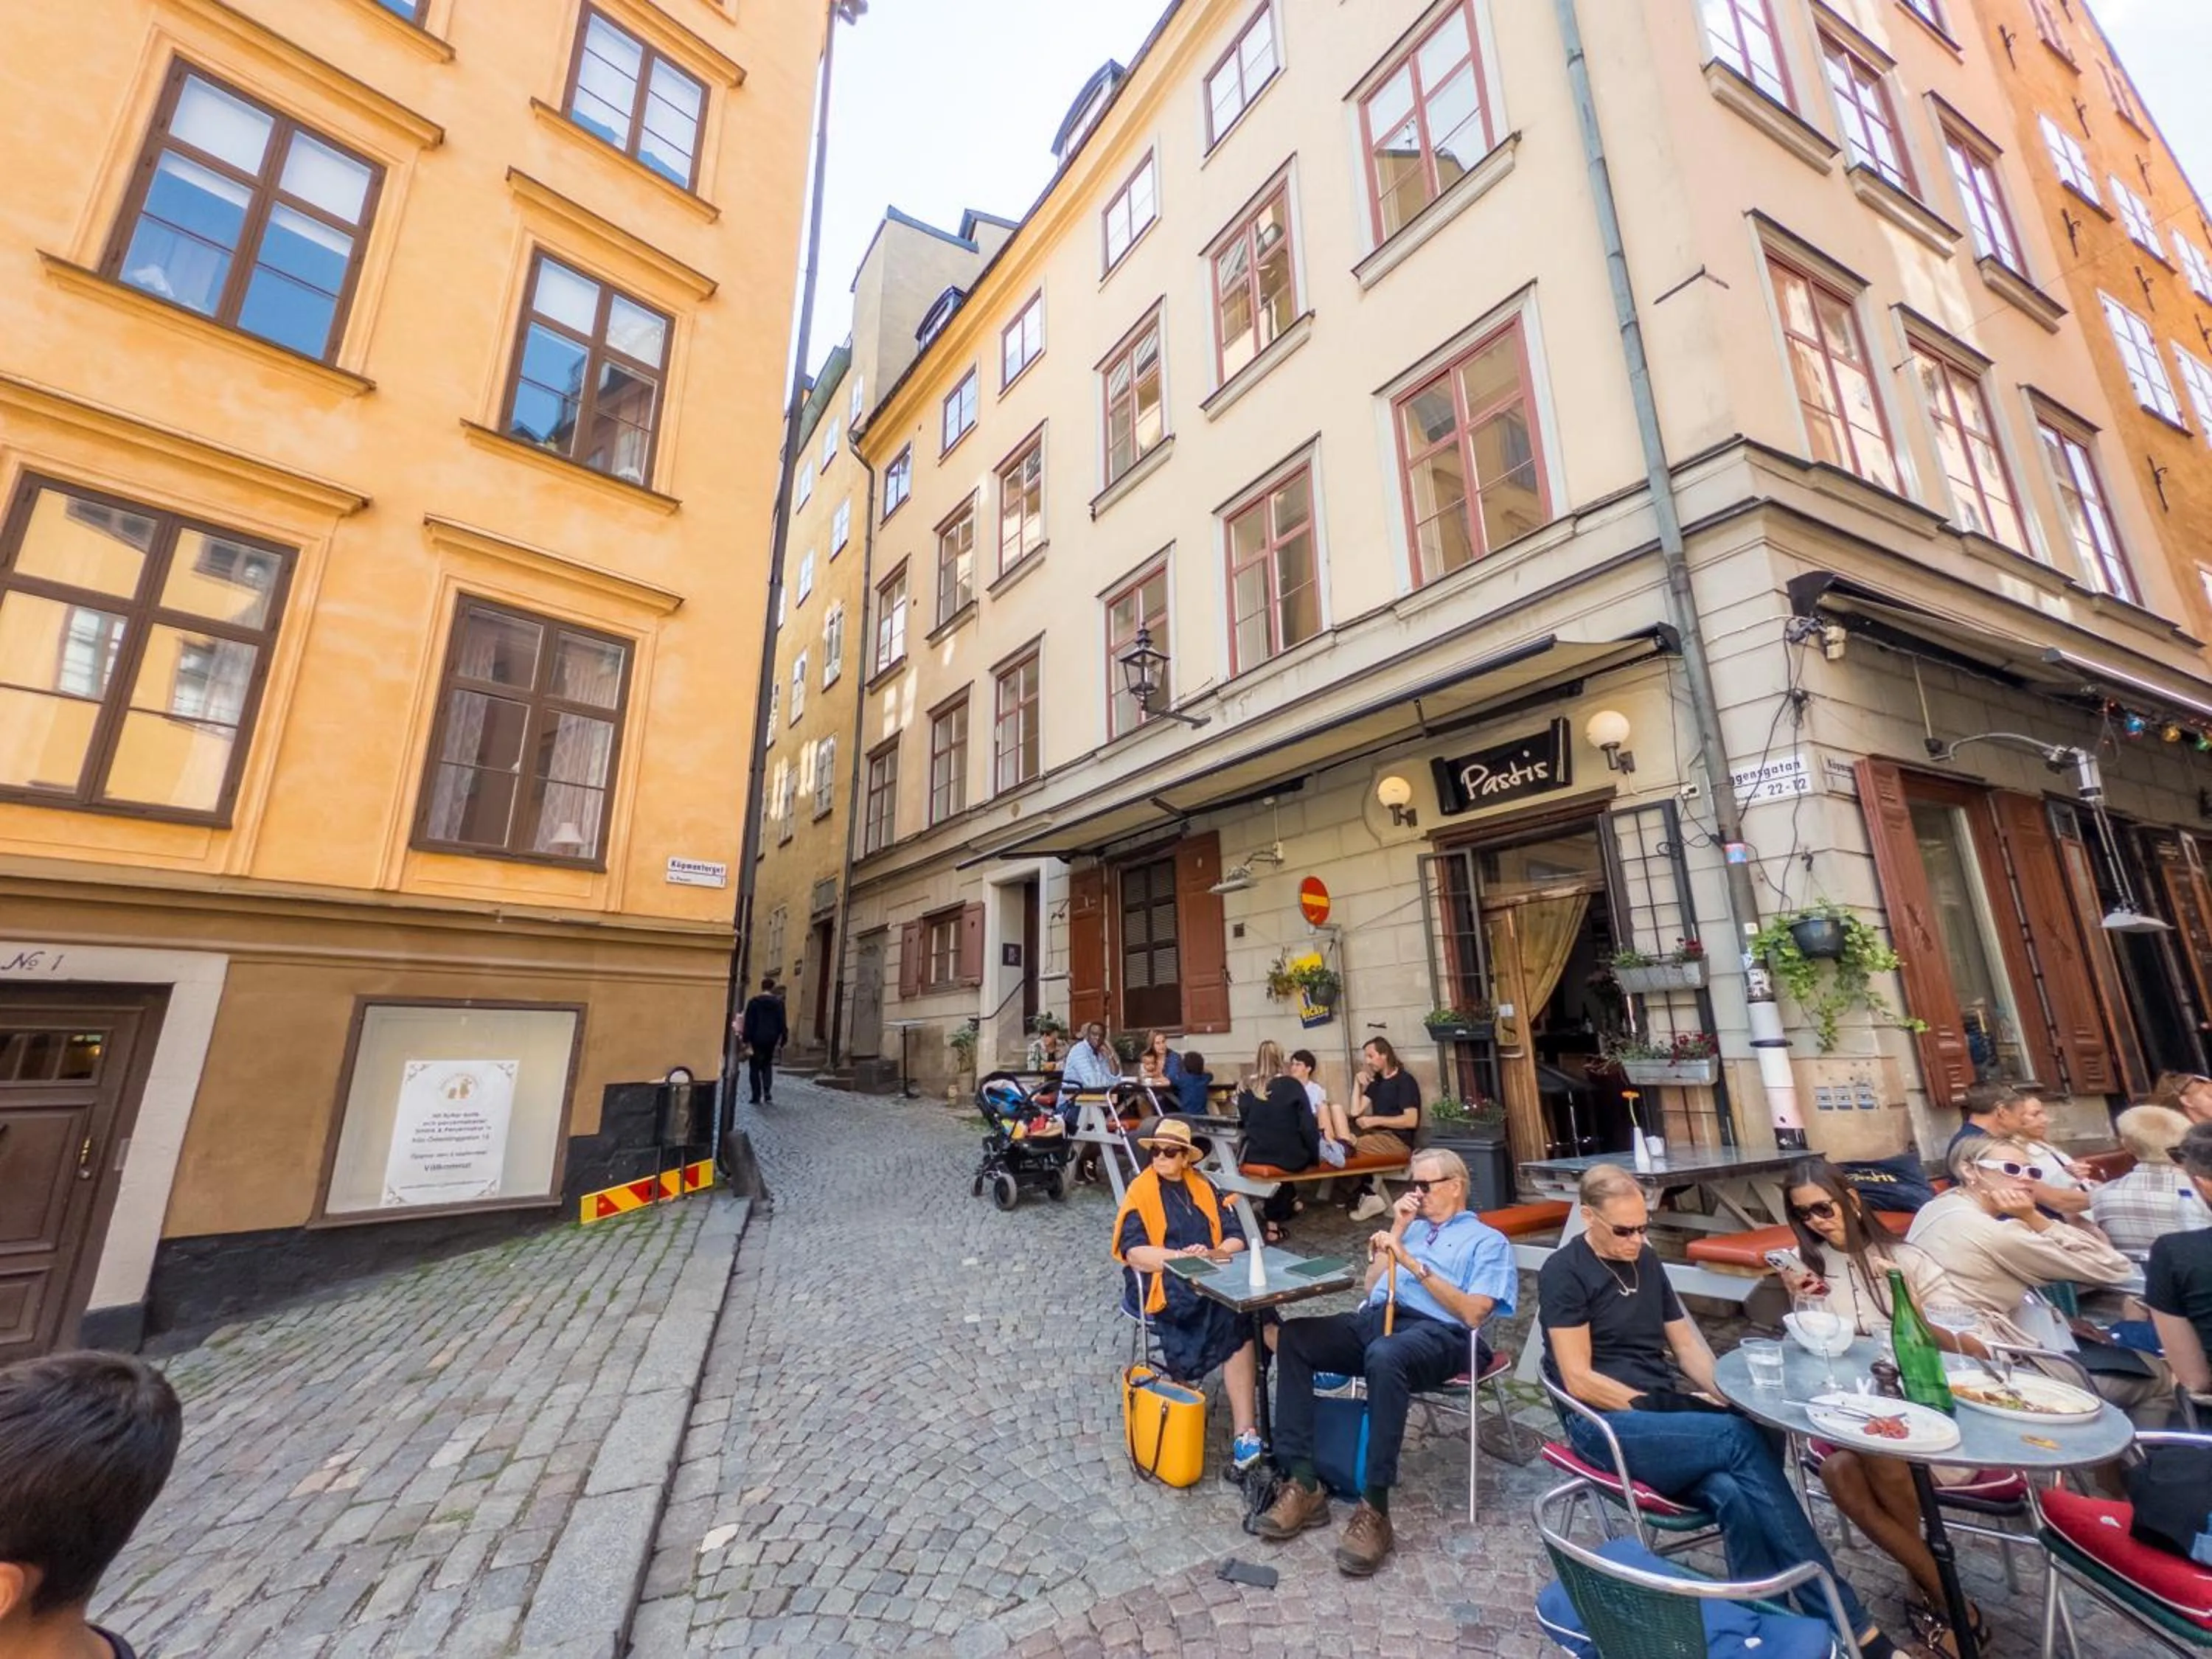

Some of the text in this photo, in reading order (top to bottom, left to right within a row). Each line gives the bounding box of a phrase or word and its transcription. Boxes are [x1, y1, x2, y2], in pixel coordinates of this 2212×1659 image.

[1461, 749, 1549, 800] Pastis
[1730, 760, 1801, 786] ggensgatan
[671, 860, 724, 875] Köpmantorget
[51, 954, 64, 971] 1
